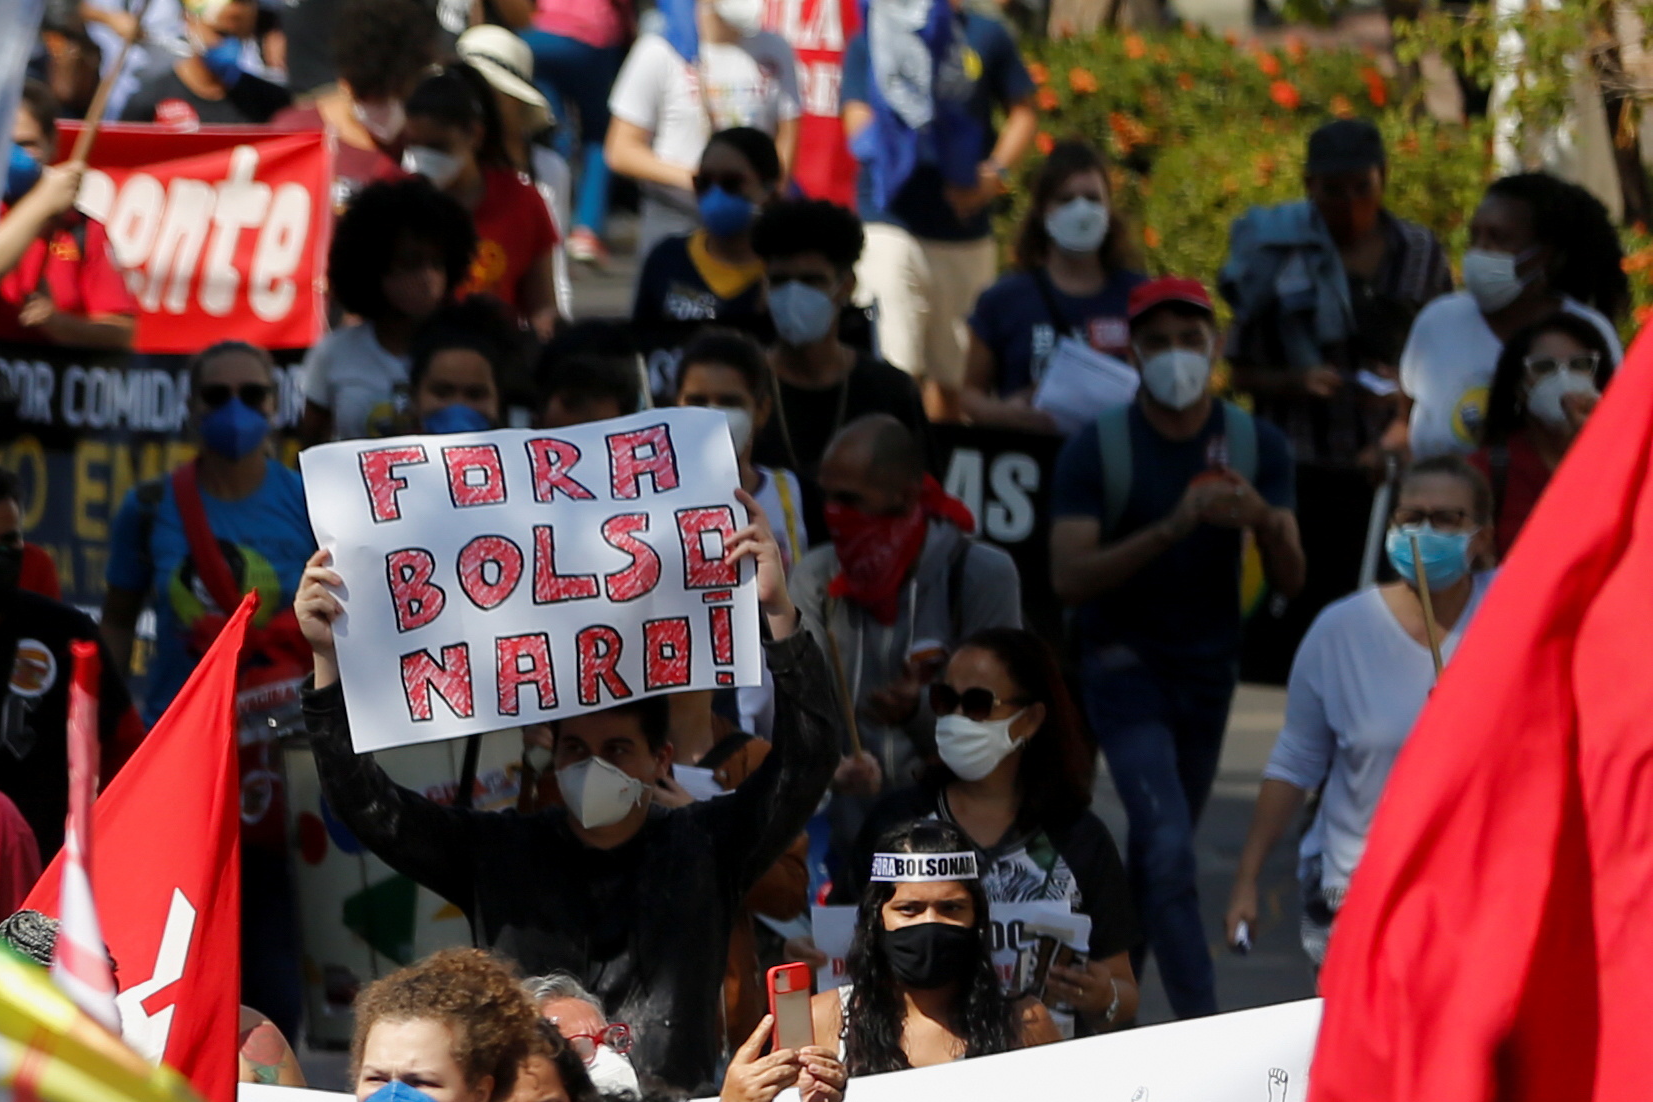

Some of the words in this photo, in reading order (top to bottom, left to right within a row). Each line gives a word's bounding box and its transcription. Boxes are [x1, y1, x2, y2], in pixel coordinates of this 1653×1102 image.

[358, 423, 680, 523] FORA
[386, 505, 740, 633] BOLSO
[400, 590, 736, 722] NARO!
